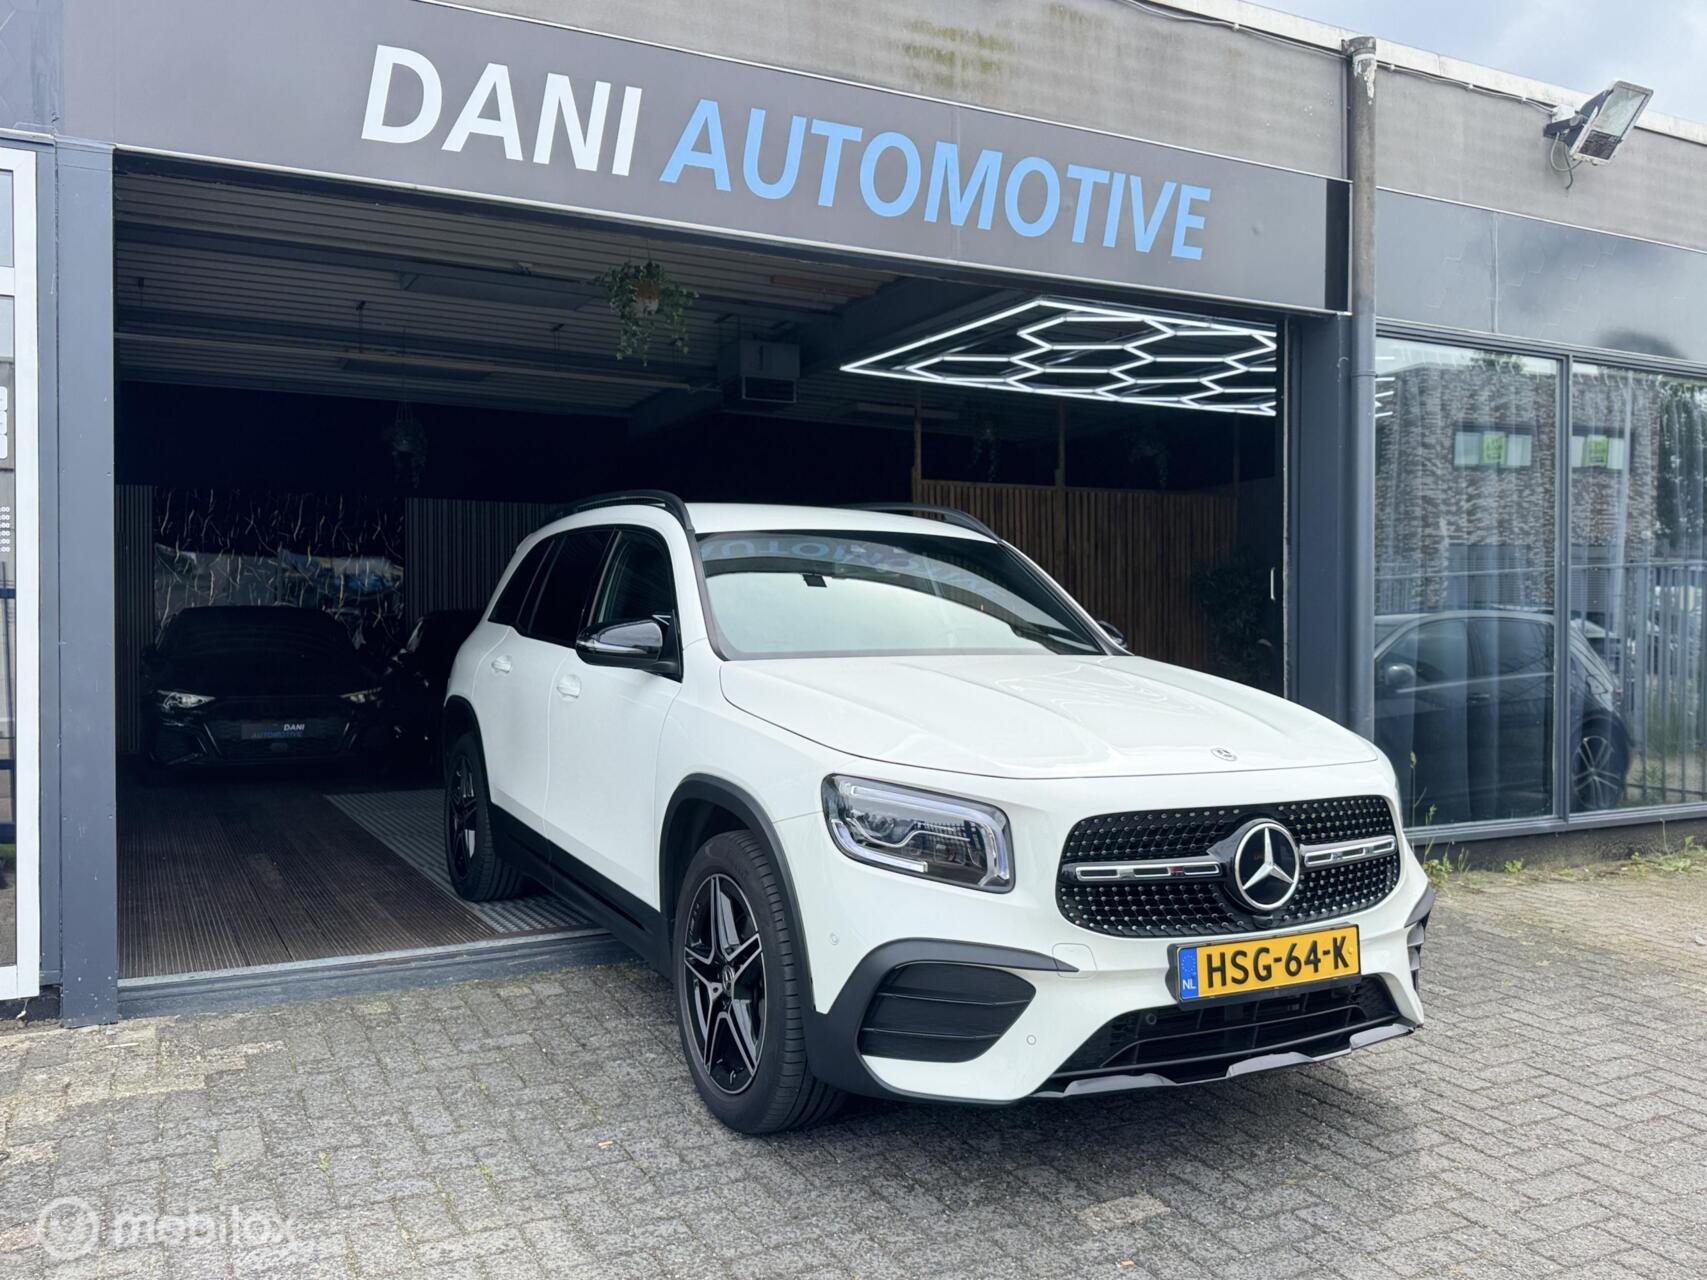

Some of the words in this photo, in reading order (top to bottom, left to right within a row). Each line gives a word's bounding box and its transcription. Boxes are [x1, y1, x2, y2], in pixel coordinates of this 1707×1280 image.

[361, 45, 643, 177] DANI
[660, 99, 1212, 261] AUTOMOTIVE
[283, 723, 305, 731] DANI
[1182, 978, 1197, 991] NL
[1206, 936, 1349, 988] HSG-64-K
